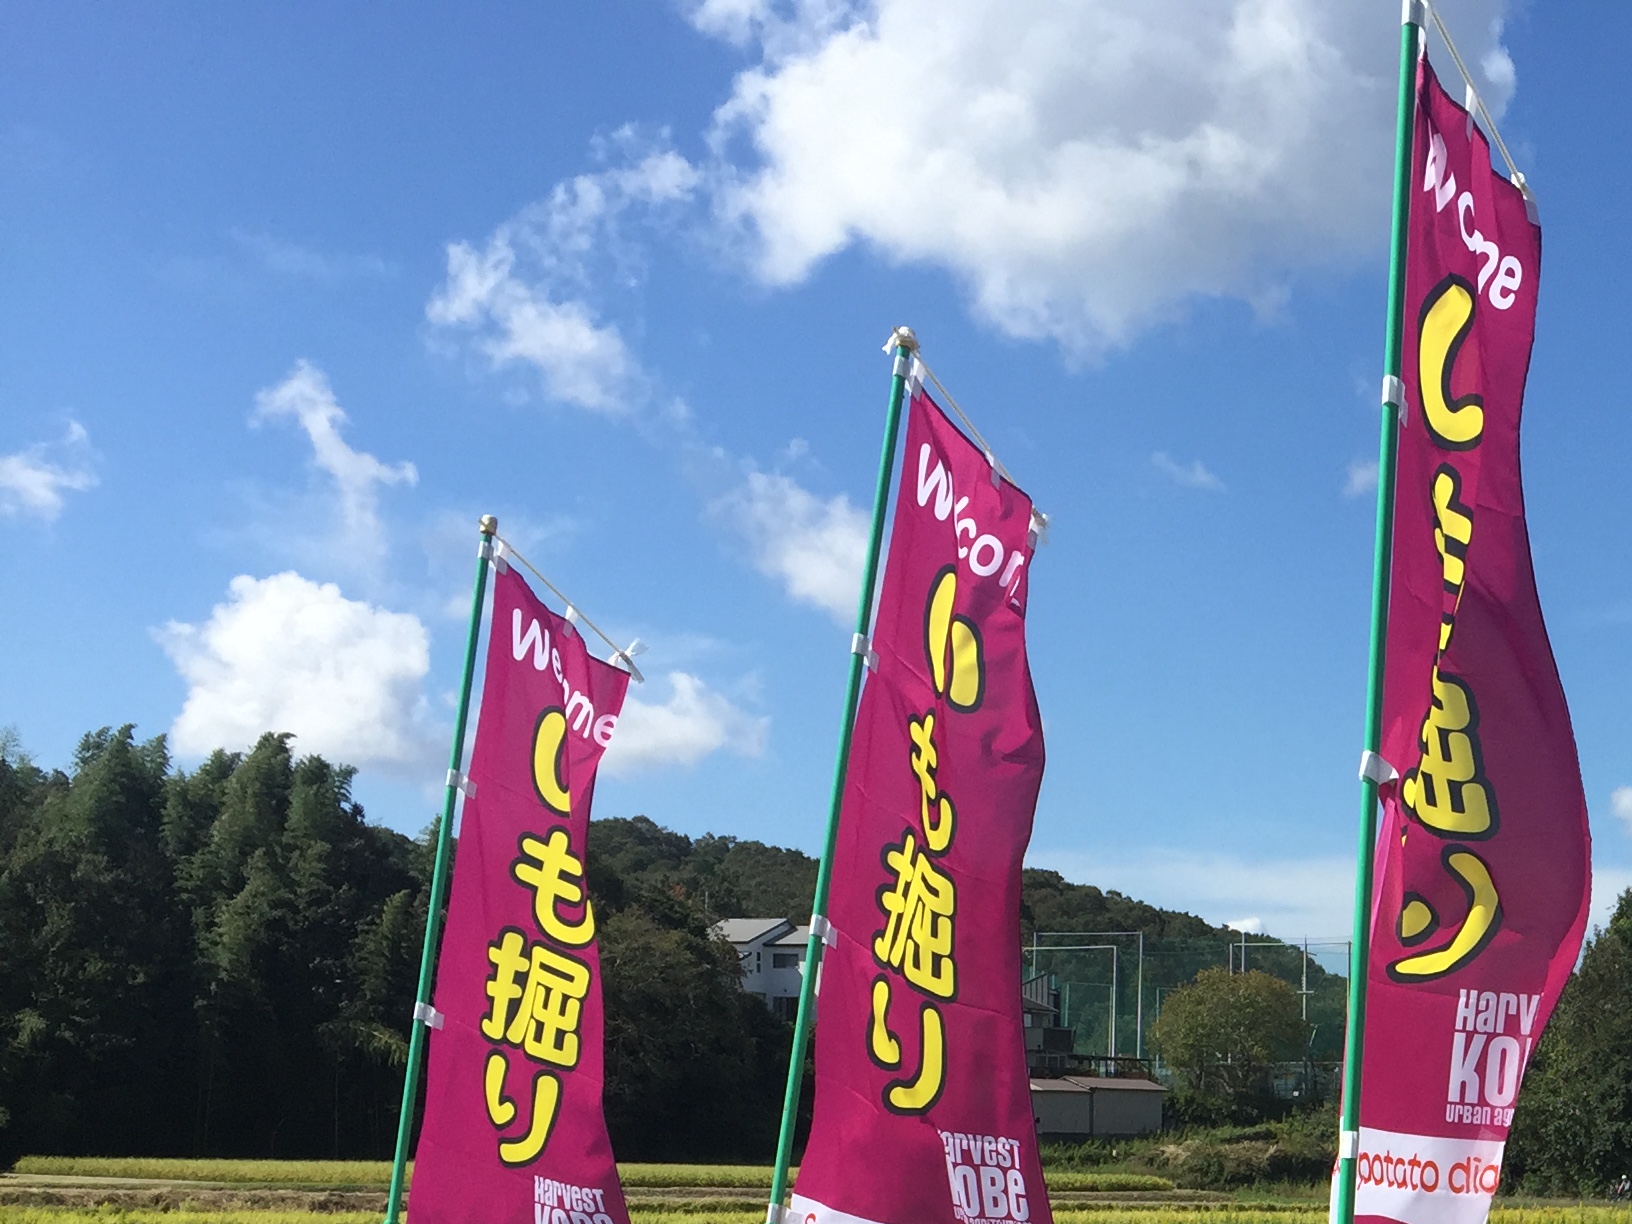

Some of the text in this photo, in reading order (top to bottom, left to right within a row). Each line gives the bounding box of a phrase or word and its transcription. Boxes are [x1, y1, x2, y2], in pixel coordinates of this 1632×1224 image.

[1455, 988, 1541, 1036] Harv
[1448, 1032, 1532, 1107] KO
[1357, 1150, 1439, 1193] potato
